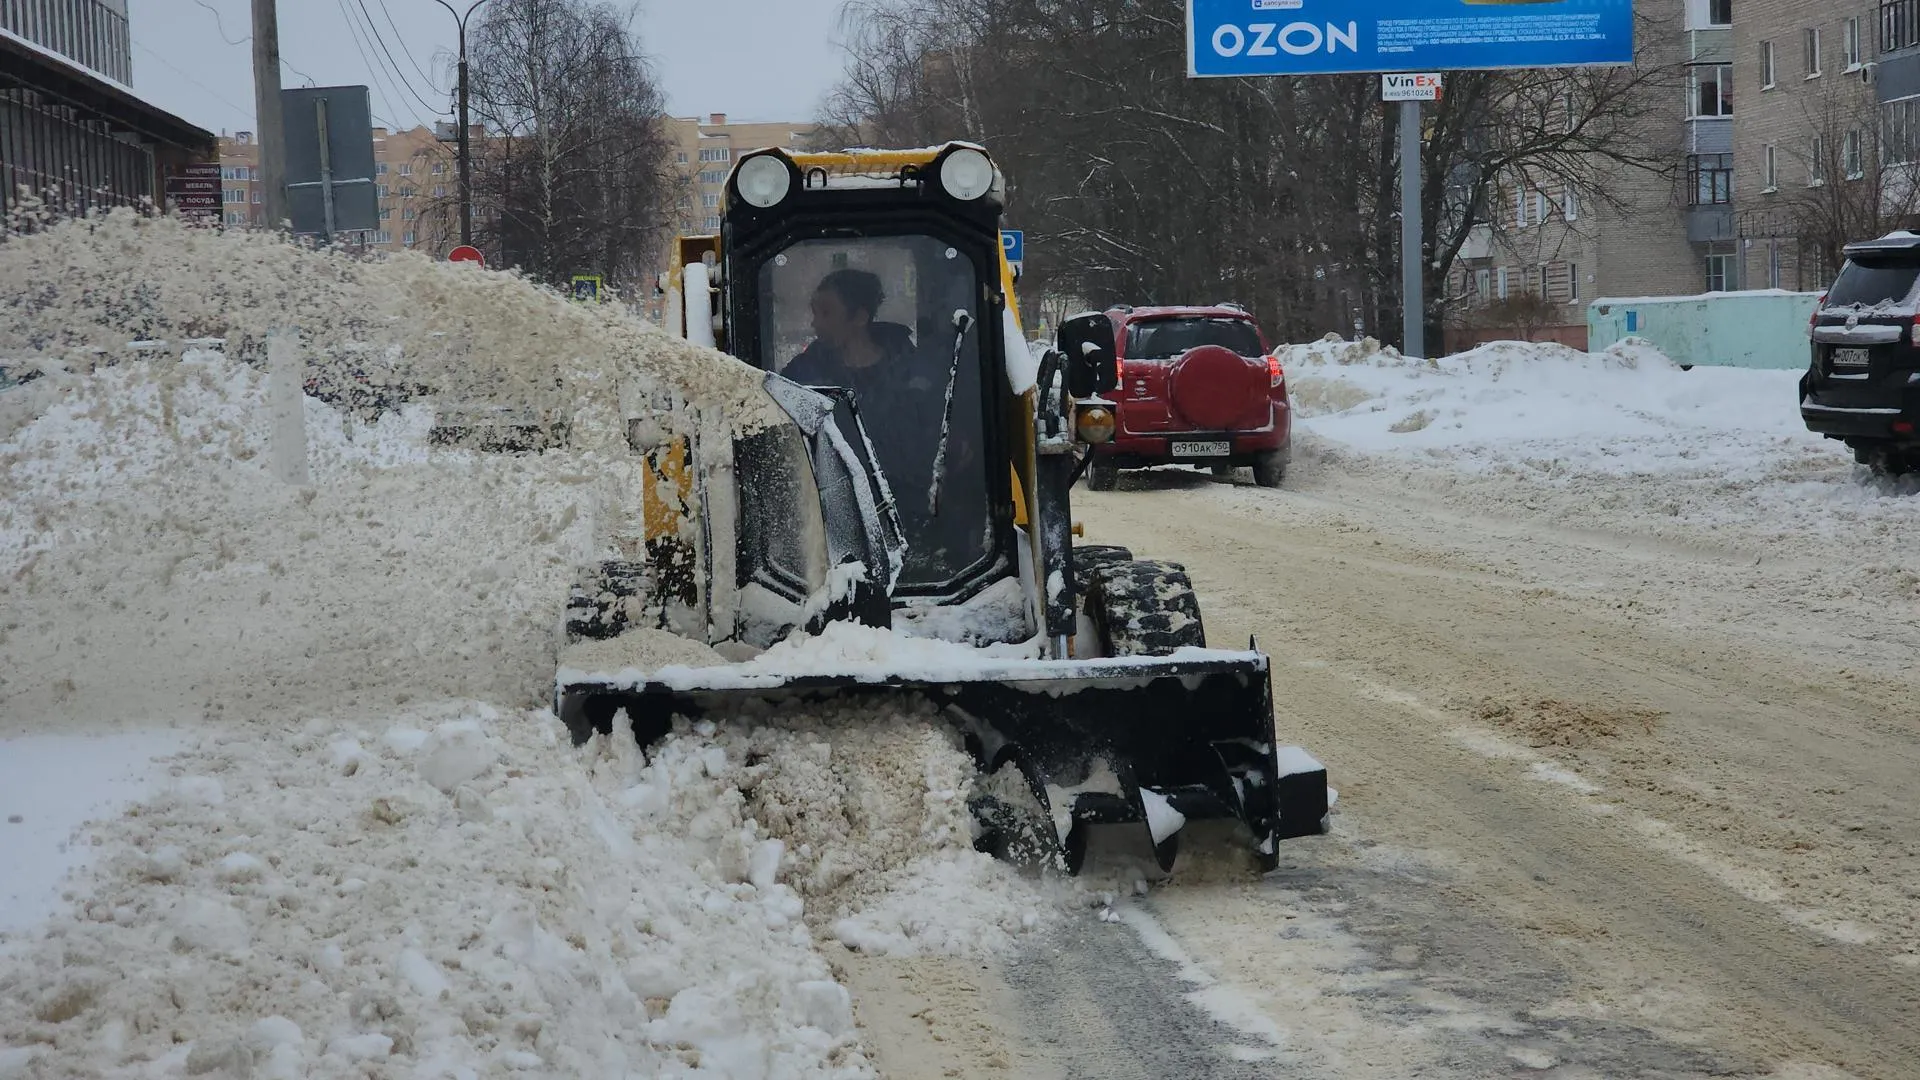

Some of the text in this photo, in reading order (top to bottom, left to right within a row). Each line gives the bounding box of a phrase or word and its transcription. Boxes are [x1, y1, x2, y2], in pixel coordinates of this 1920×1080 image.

[1212, 21, 1357, 57] OZON
[1387, 75, 1435, 87] VinEx
[1401, 89, 1434, 97] 9610245
